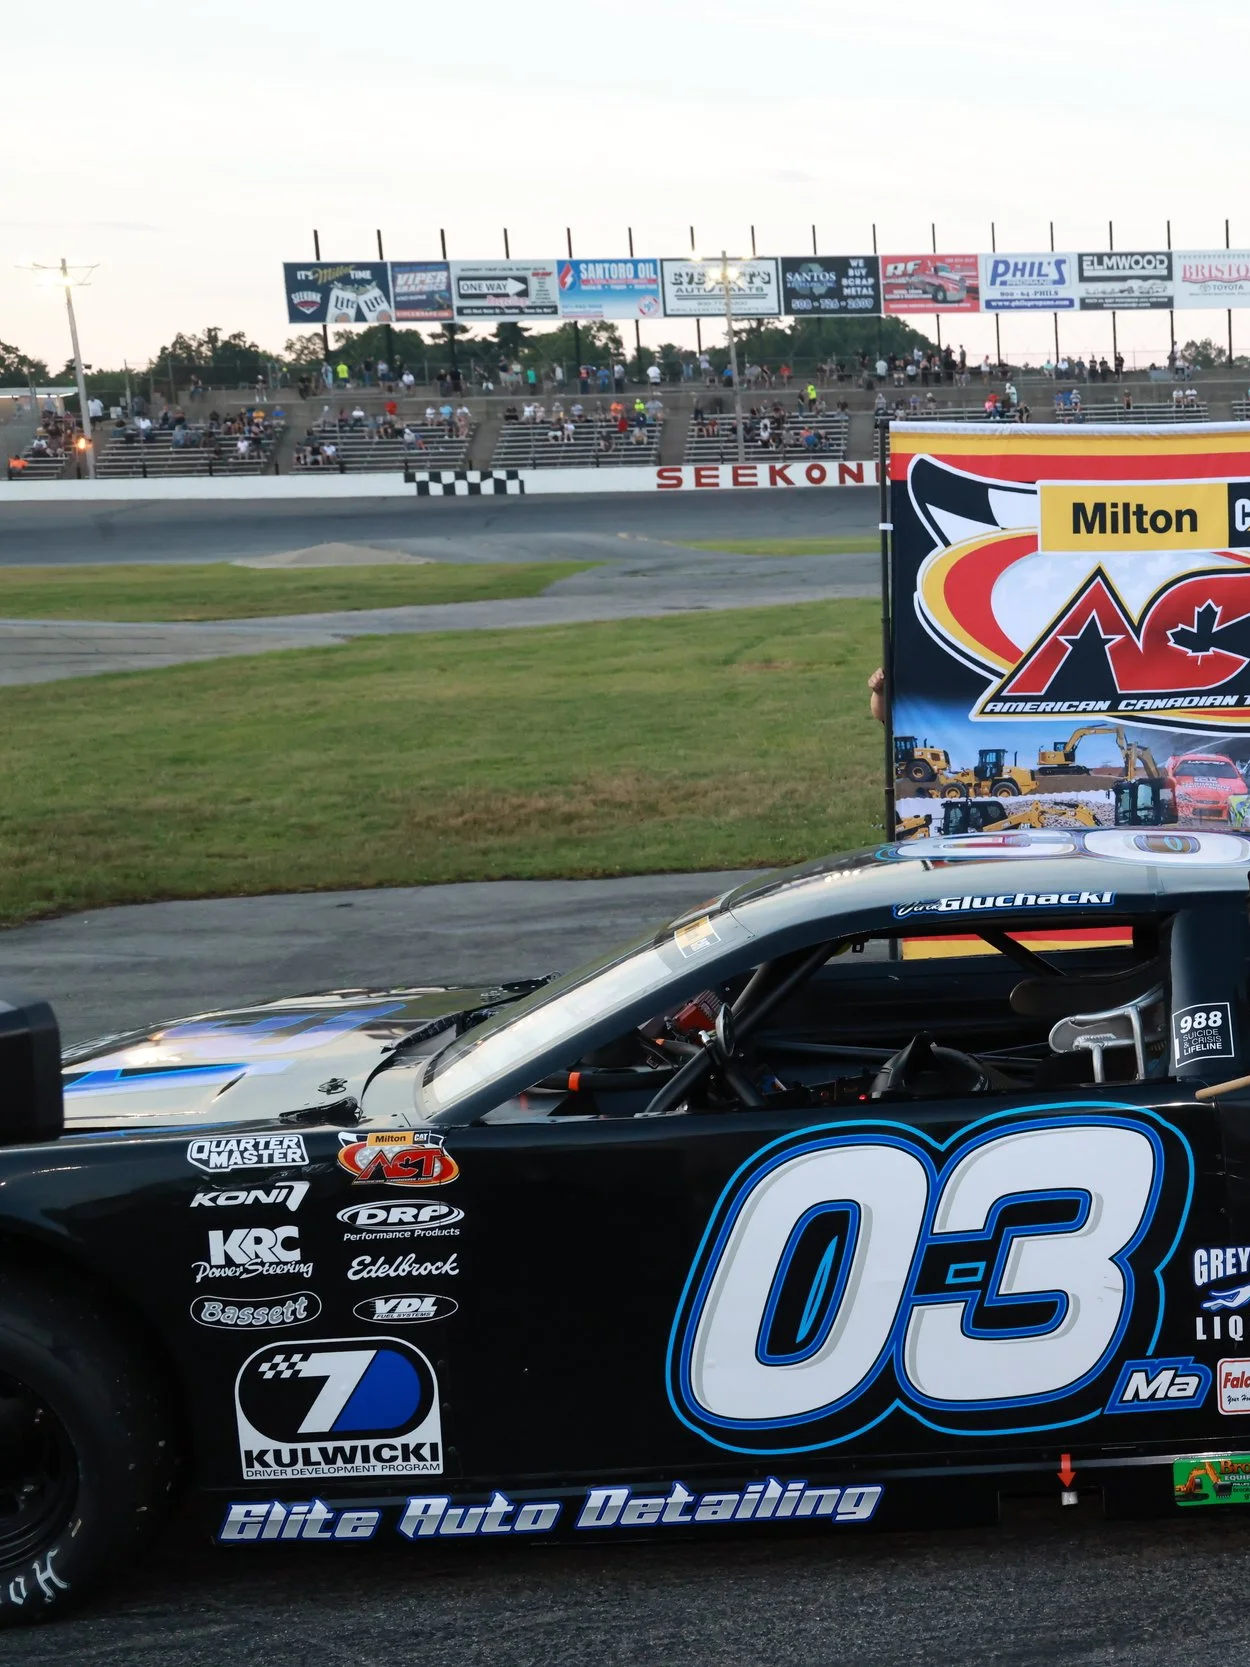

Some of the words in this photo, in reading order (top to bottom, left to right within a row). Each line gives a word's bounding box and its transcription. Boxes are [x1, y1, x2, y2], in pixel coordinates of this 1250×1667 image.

[580, 263, 634, 280] SANTORO
[638, 262, 657, 279] OIL
[850, 259, 865, 268] WE
[886, 260, 922, 277] RF
[1082, 254, 1169, 271] ELMWOOD
[296, 270, 313, 280] IT'S
[350, 270, 372, 280] TIME
[396, 271, 448, 285] VIPER
[786, 272, 836, 281] SANTOS
[841, 277, 875, 286] SCRAP
[848, 268, 867, 277] BUY
[990, 259, 1067, 286] PHIL'S
[461, 281, 484, 292] ONE
[484, 281, 508, 292] WAY
[842, 286, 875, 296] METAL
[1072, 502, 1198, 534] Milton
[983, 700, 1111, 714] AMERICAN
[1117, 693, 1241, 712] CANADIAN
[938, 891, 1114, 913] Gluchacki
[1180, 1010, 1222, 1034] 988
[1183, 1028, 1219, 1042] SUICIDE
[1191, 1035, 1222, 1046] CRISIS
[1183, 1042, 1223, 1056] LIFELINE
[375, 1135, 407, 1143] Milton
[414, 1133, 429, 1142] CAT
[189, 1136, 300, 1161] QUARTER
[208, 1148, 304, 1168] MASTER
[359, 1149, 443, 1181] ACT
[190, 1188, 289, 1208] KONI
[356, 1205, 450, 1225] DRP
[343, 1231, 411, 1241] Performance
[414, 1228, 460, 1238] Products
[208, 1225, 301, 1266] KRC
[191, 1261, 244, 1283] Power
[239, 1258, 314, 1280] Steering
[347, 1252, 460, 1281] Edelbrock
[682, 1117, 1162, 1428] 03
[201, 1296, 308, 1326] Bassett
[374, 1297, 438, 1313] VDL
[1122, 1369, 1200, 1401] Ma
[1227, 1394, 1239, 1405] Your
[243, 1442, 440, 1469] KULWICKI
[246, 1469, 288, 1478] DRIVER
[291, 1464, 378, 1476] DEVELOPMENT
[381, 1463, 440, 1472] PROGRAM
[219, 1499, 380, 1540] Elite
[399, 1492, 560, 1538] Auto
[576, 1477, 882, 1527] Detailing
